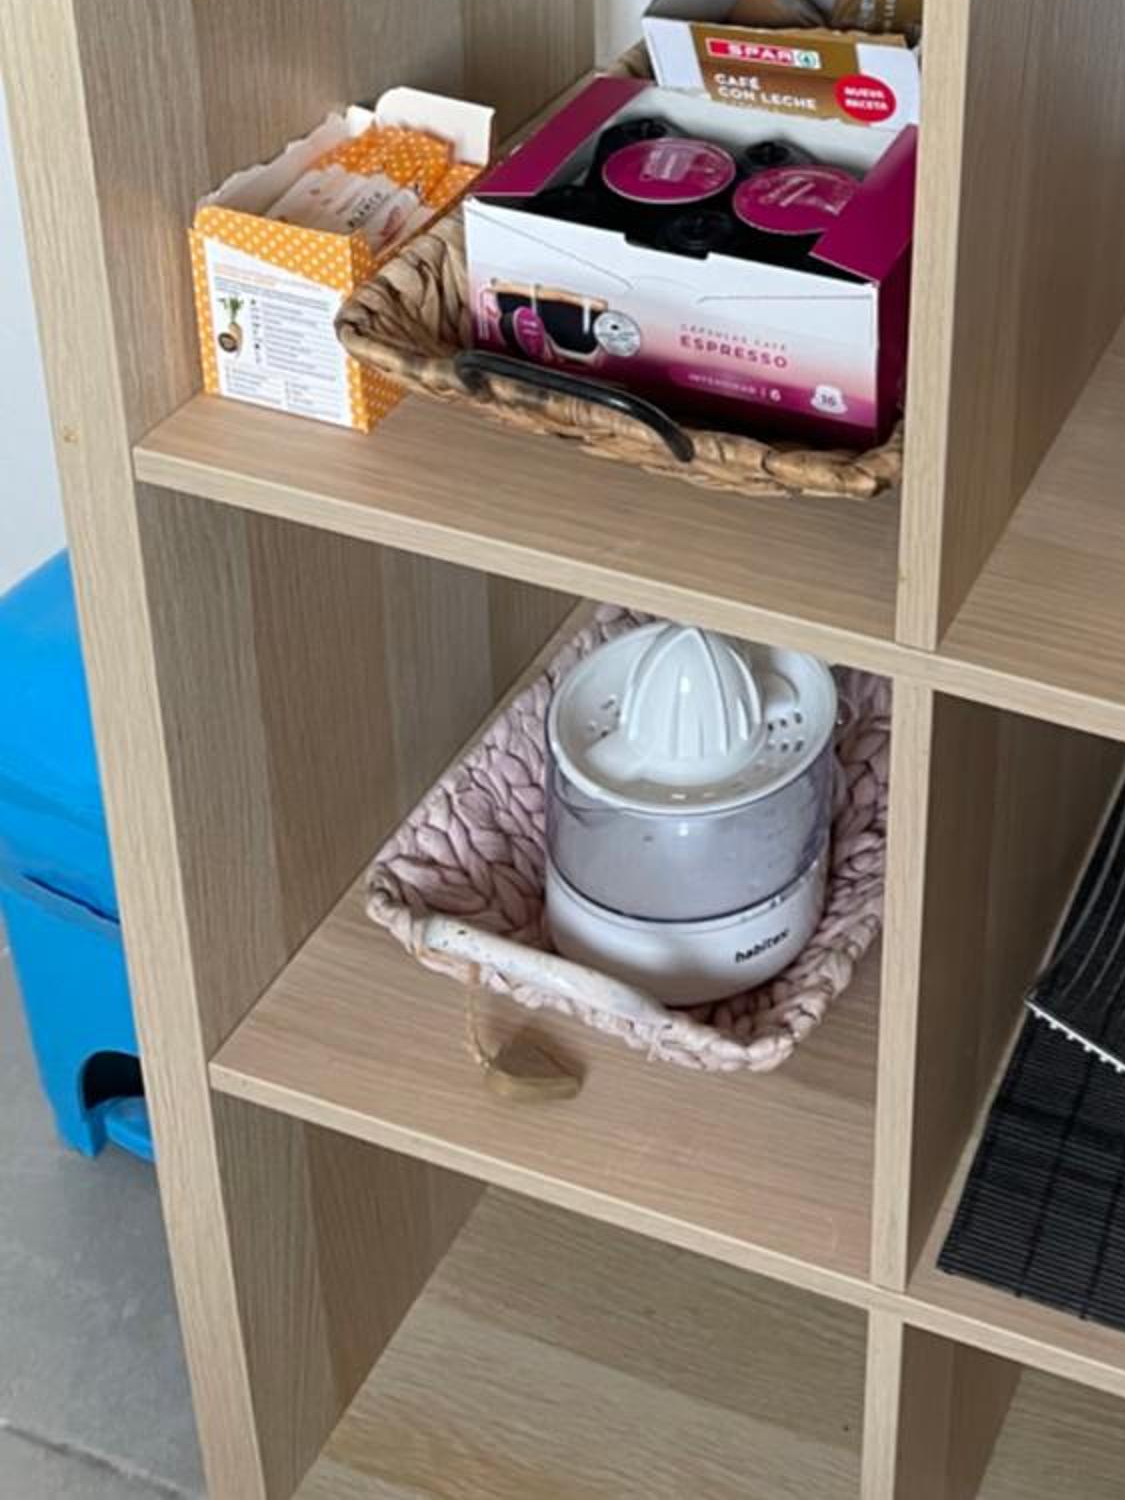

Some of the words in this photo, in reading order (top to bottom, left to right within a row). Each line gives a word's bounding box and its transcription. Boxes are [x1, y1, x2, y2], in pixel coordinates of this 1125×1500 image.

[727, 42, 793, 63] SPAR
[718, 86, 756, 101] CON
[761, 94, 817, 111] LECHE
[679, 335, 788, 369] ESPRESSO
